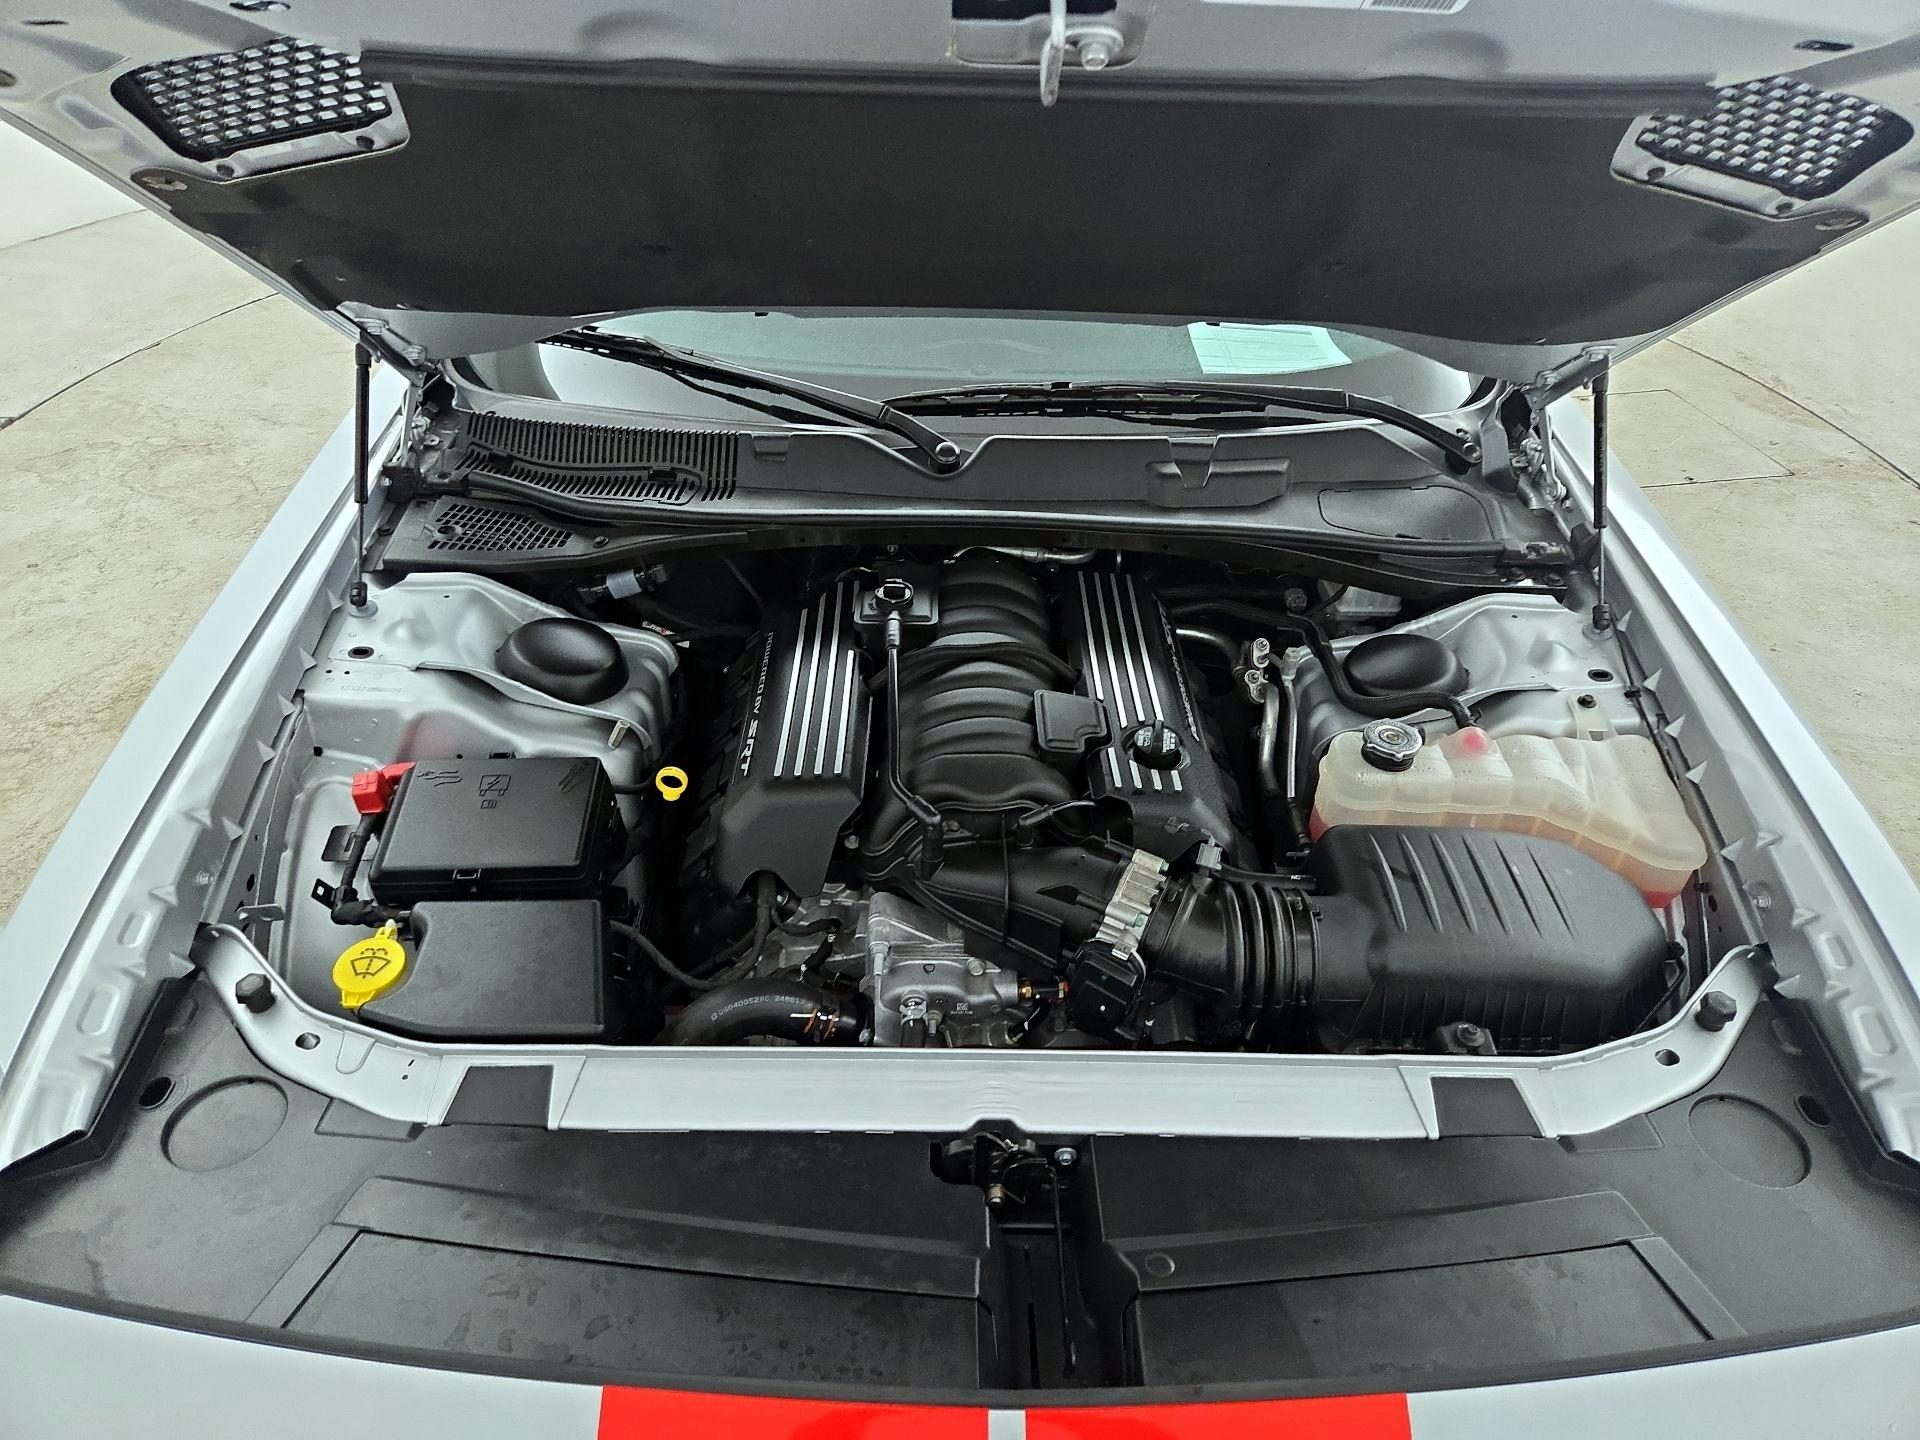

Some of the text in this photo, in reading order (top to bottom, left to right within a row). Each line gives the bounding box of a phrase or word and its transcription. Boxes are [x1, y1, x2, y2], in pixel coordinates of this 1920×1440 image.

[740, 632, 774, 776] POWERED BY SRT
